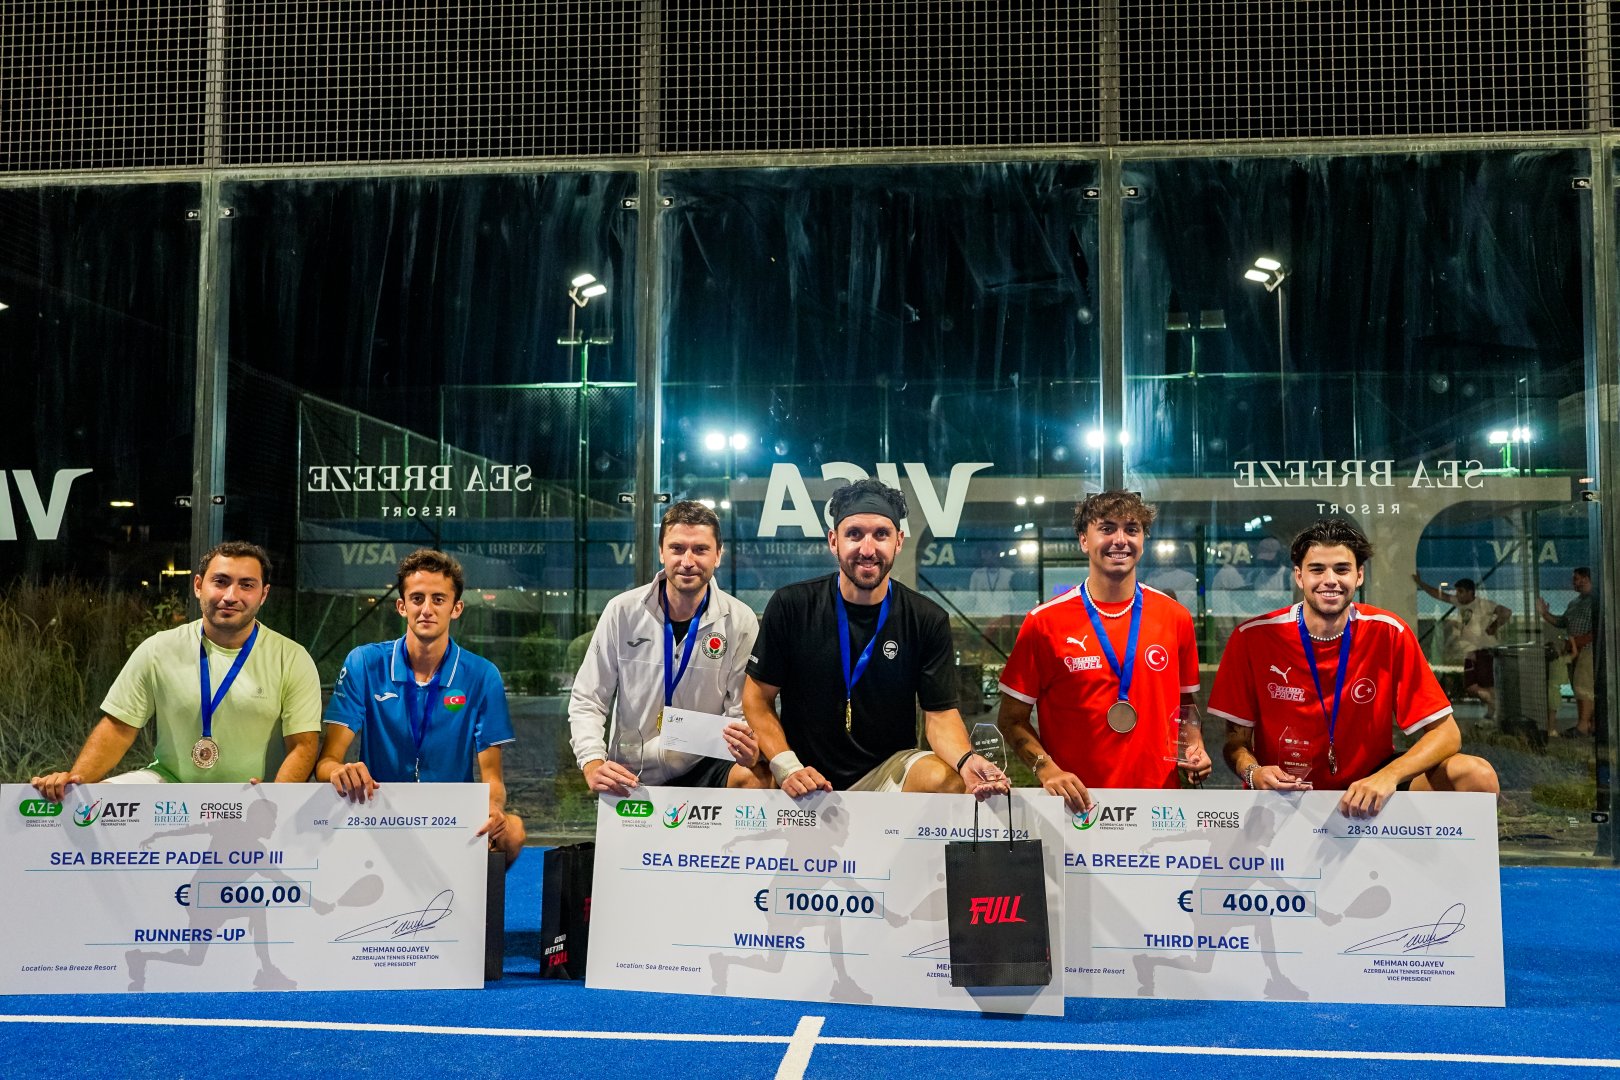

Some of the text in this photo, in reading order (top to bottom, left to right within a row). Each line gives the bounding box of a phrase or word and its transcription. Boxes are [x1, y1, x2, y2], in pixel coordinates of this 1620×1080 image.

[339, 543, 397, 565] VISA
[920, 542, 956, 566] SA
[26, 802, 55, 814] AZE
[101, 802, 141, 818] ATF
[154, 801, 189, 815] SEA
[200, 802, 243, 811] CROCUS
[622, 802, 648, 815] AZE
[688, 805, 723, 820] ATF
[735, 805, 767, 820] SEA
[777, 809, 817, 818] CROCUS
[1151, 805, 1187, 820] SEA
[154, 815, 190, 823] BREEZE
[347, 816, 377, 826] 28-30
[380, 816, 429, 826] AUGUST
[431, 816, 457, 826] 2024
[1100, 806, 1137, 822] ATF
[1197, 811, 1240, 820] CROCUS
[735, 819, 768, 828] BREEZE
[1151, 820, 1187, 828] BREEZE
[1347, 825, 1378, 835] 28-30
[1381, 825, 1432, 836] AUGUST
[1435, 826, 1463, 836] 2024
[917, 826, 947, 837] 28-30
[950, 827, 1000, 839] AUGUST
[50, 851, 284, 865] SEA BREEZE PADEL CUP III
[642, 852, 856, 874] SEA BREEZE PADEL CUP III
[1064, 853, 1285, 871] EA BREEZE PADEL CUP III
[174, 883, 301, 907] € 600,00
[753, 888, 875, 916] € 1000,00
[969, 894, 1028, 925] FULL
[1177, 889, 1306, 916] € 400,00
[134, 928, 213, 942] RUNNERS
[733, 933, 806, 950] WINNERS
[1143, 933, 1250, 950] THIRD PLACE
[396, 945, 430, 953] GOJAYEV
[21, 964, 54, 972] Location:
[616, 961, 702, 973] Location: Sea Breeze Resort
[1064, 966, 1077, 974] Sea
[1102, 967, 1126, 975] Resort
[1373, 959, 1445, 968] MEHMAN GOJAYEV
